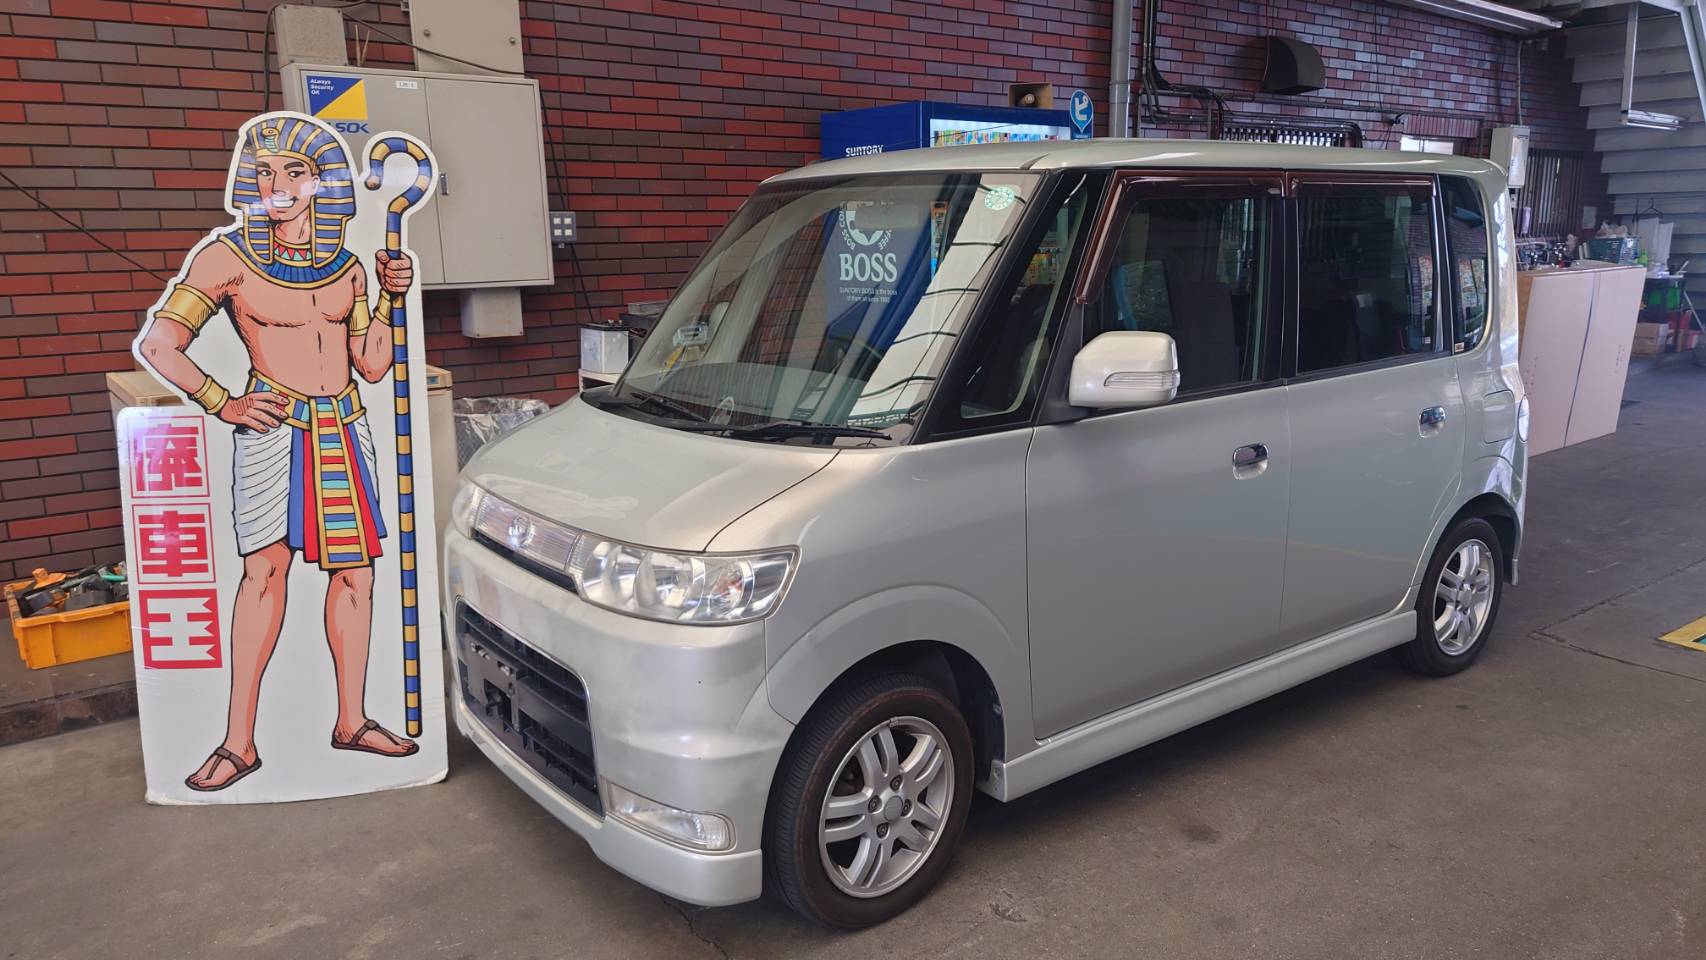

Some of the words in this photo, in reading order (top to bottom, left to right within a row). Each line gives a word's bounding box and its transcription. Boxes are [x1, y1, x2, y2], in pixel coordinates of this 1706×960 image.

[328, 122, 370, 134] SOK
[845, 144, 884, 157] SUNTORY
[839, 252, 898, 283] BOSS
